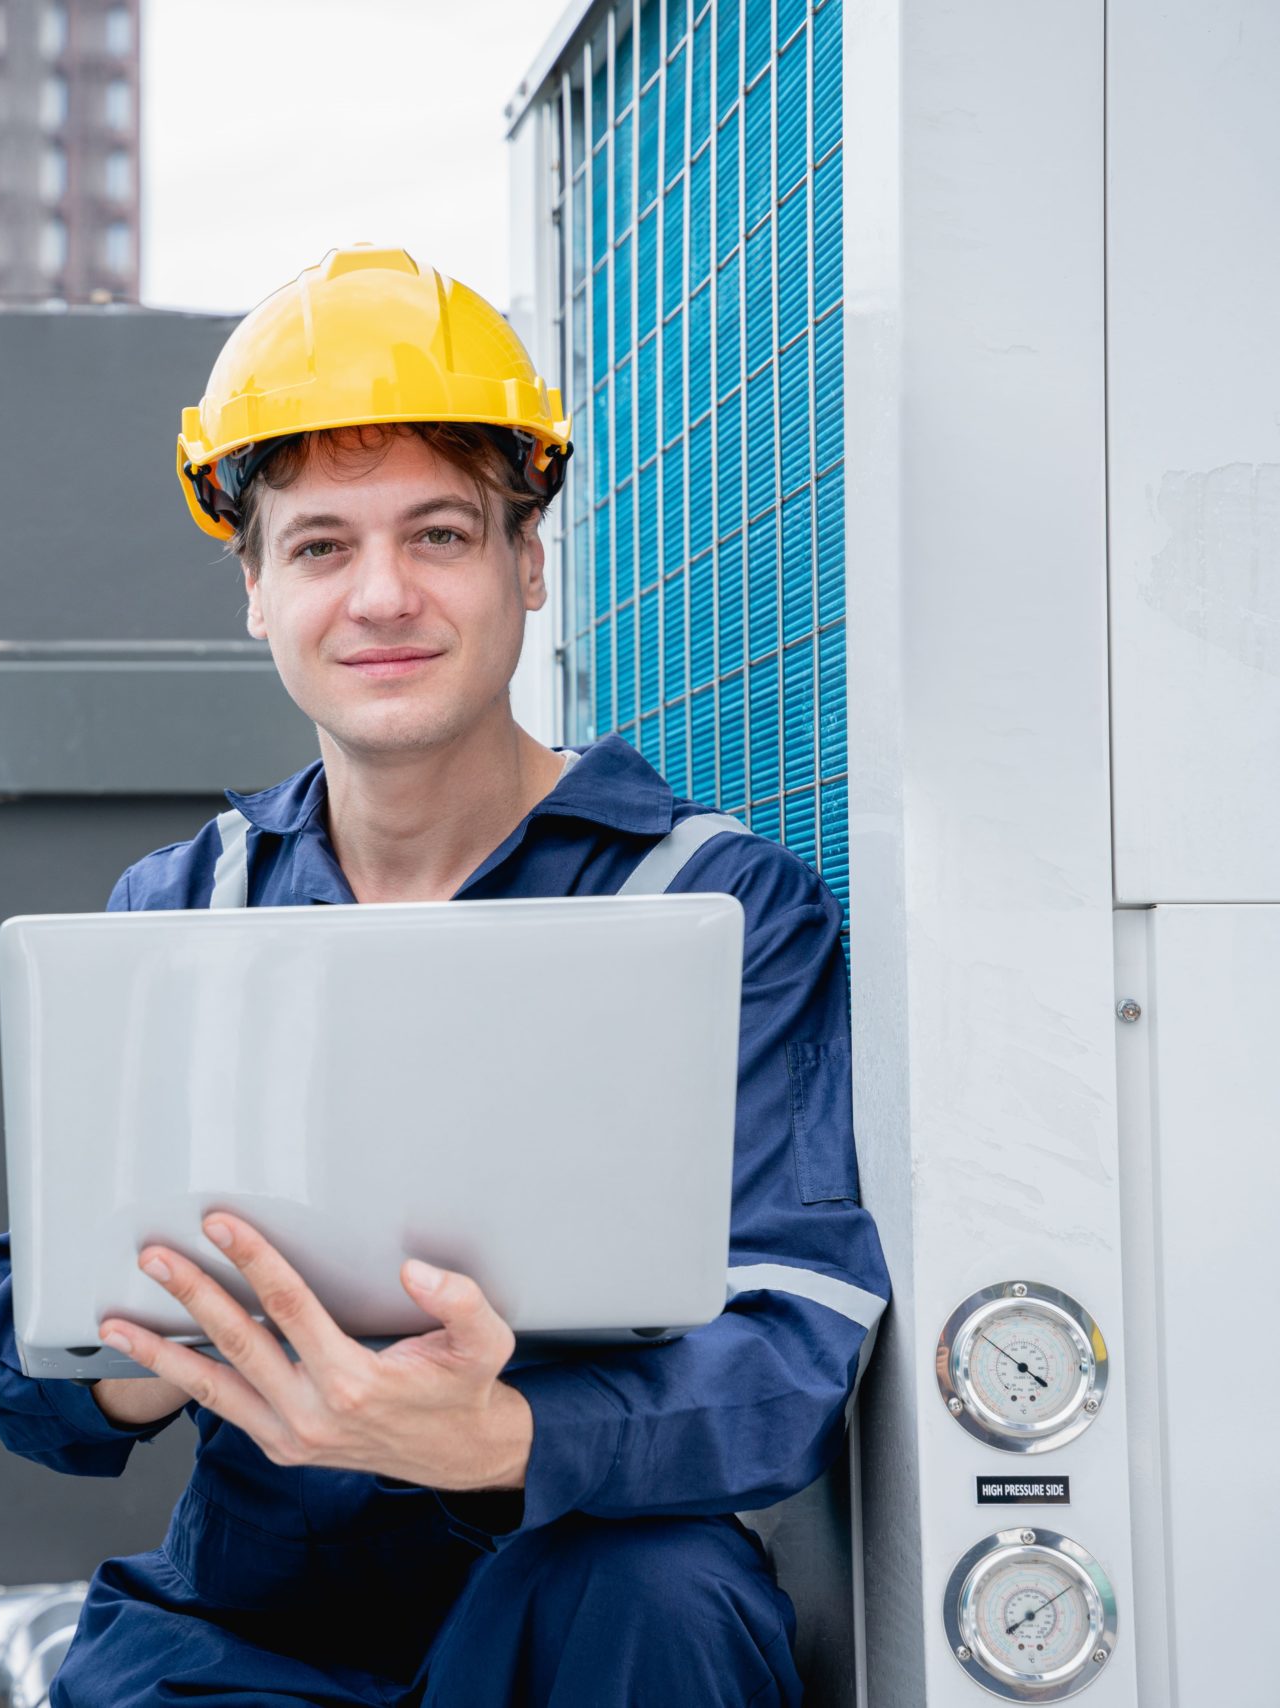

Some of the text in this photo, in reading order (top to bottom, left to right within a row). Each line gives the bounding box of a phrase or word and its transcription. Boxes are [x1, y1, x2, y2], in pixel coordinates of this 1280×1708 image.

[982, 1484, 1064, 1496] HIGH PRESSURE SIDE
